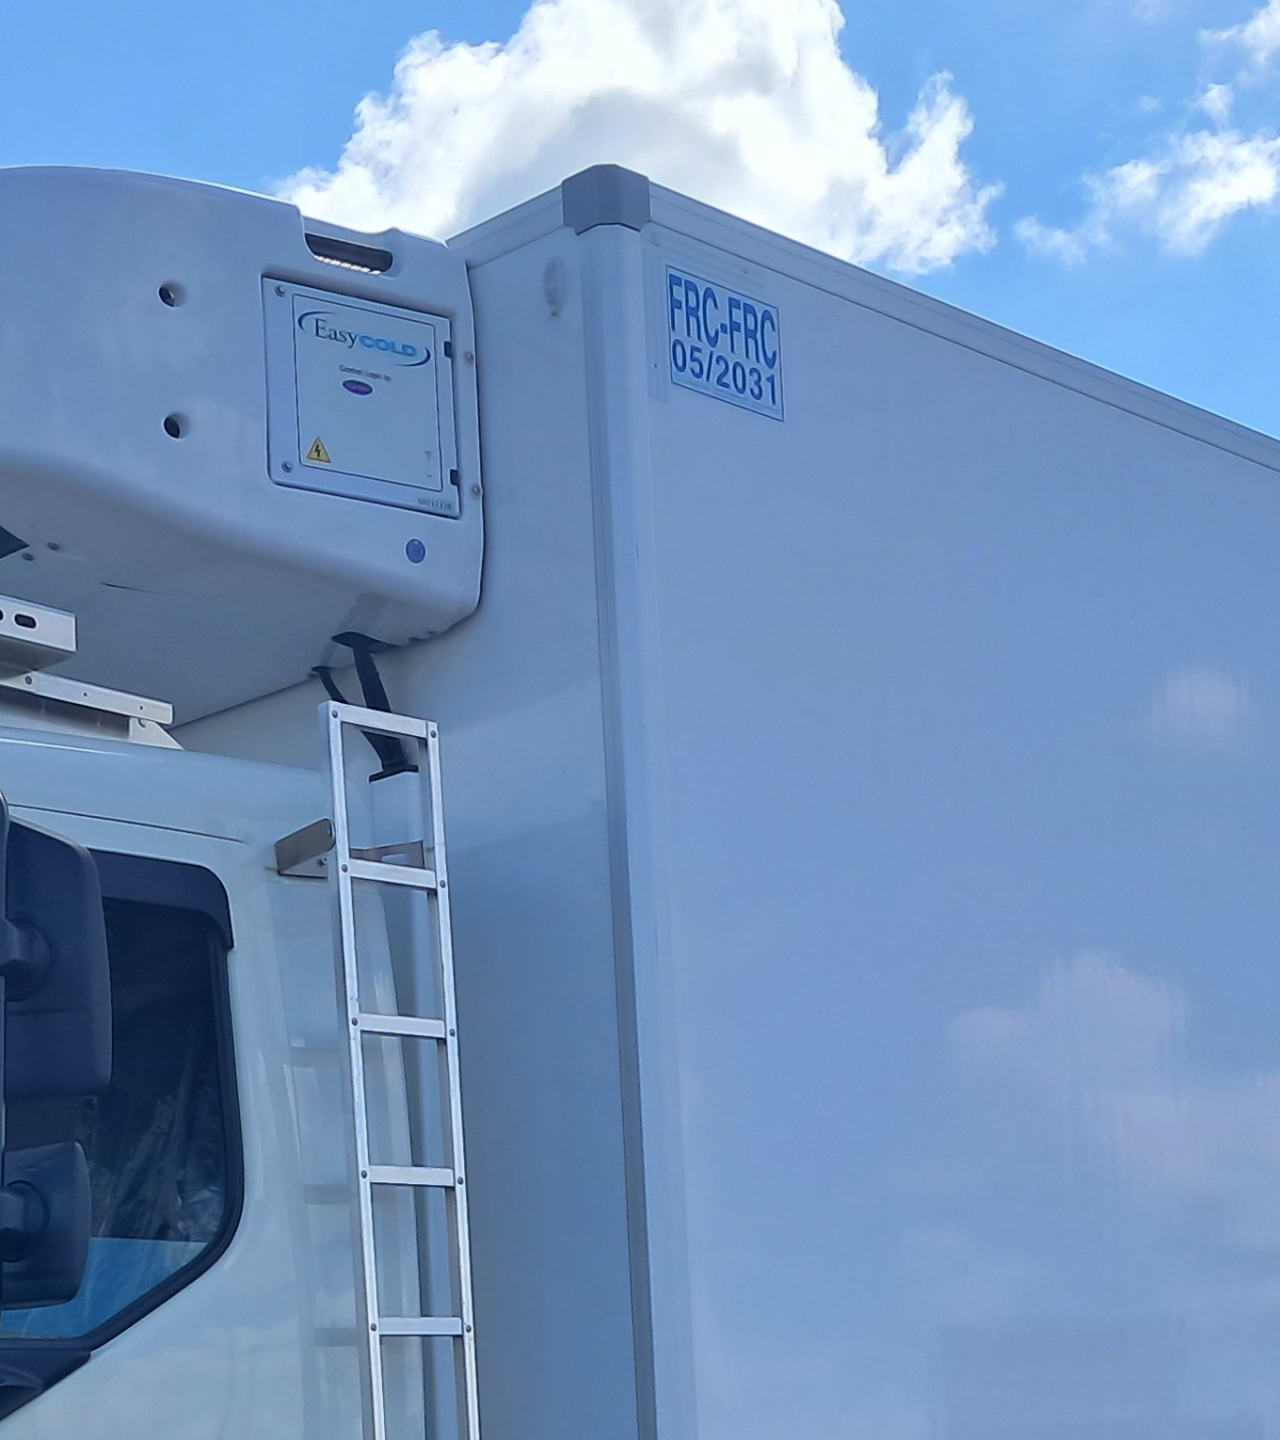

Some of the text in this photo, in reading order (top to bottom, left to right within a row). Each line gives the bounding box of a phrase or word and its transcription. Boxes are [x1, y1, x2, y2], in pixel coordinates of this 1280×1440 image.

[314, 318, 417, 357] EasyCOLD
[668, 273, 777, 370] FRC-FRC
[672, 338, 777, 406] 05/2031
